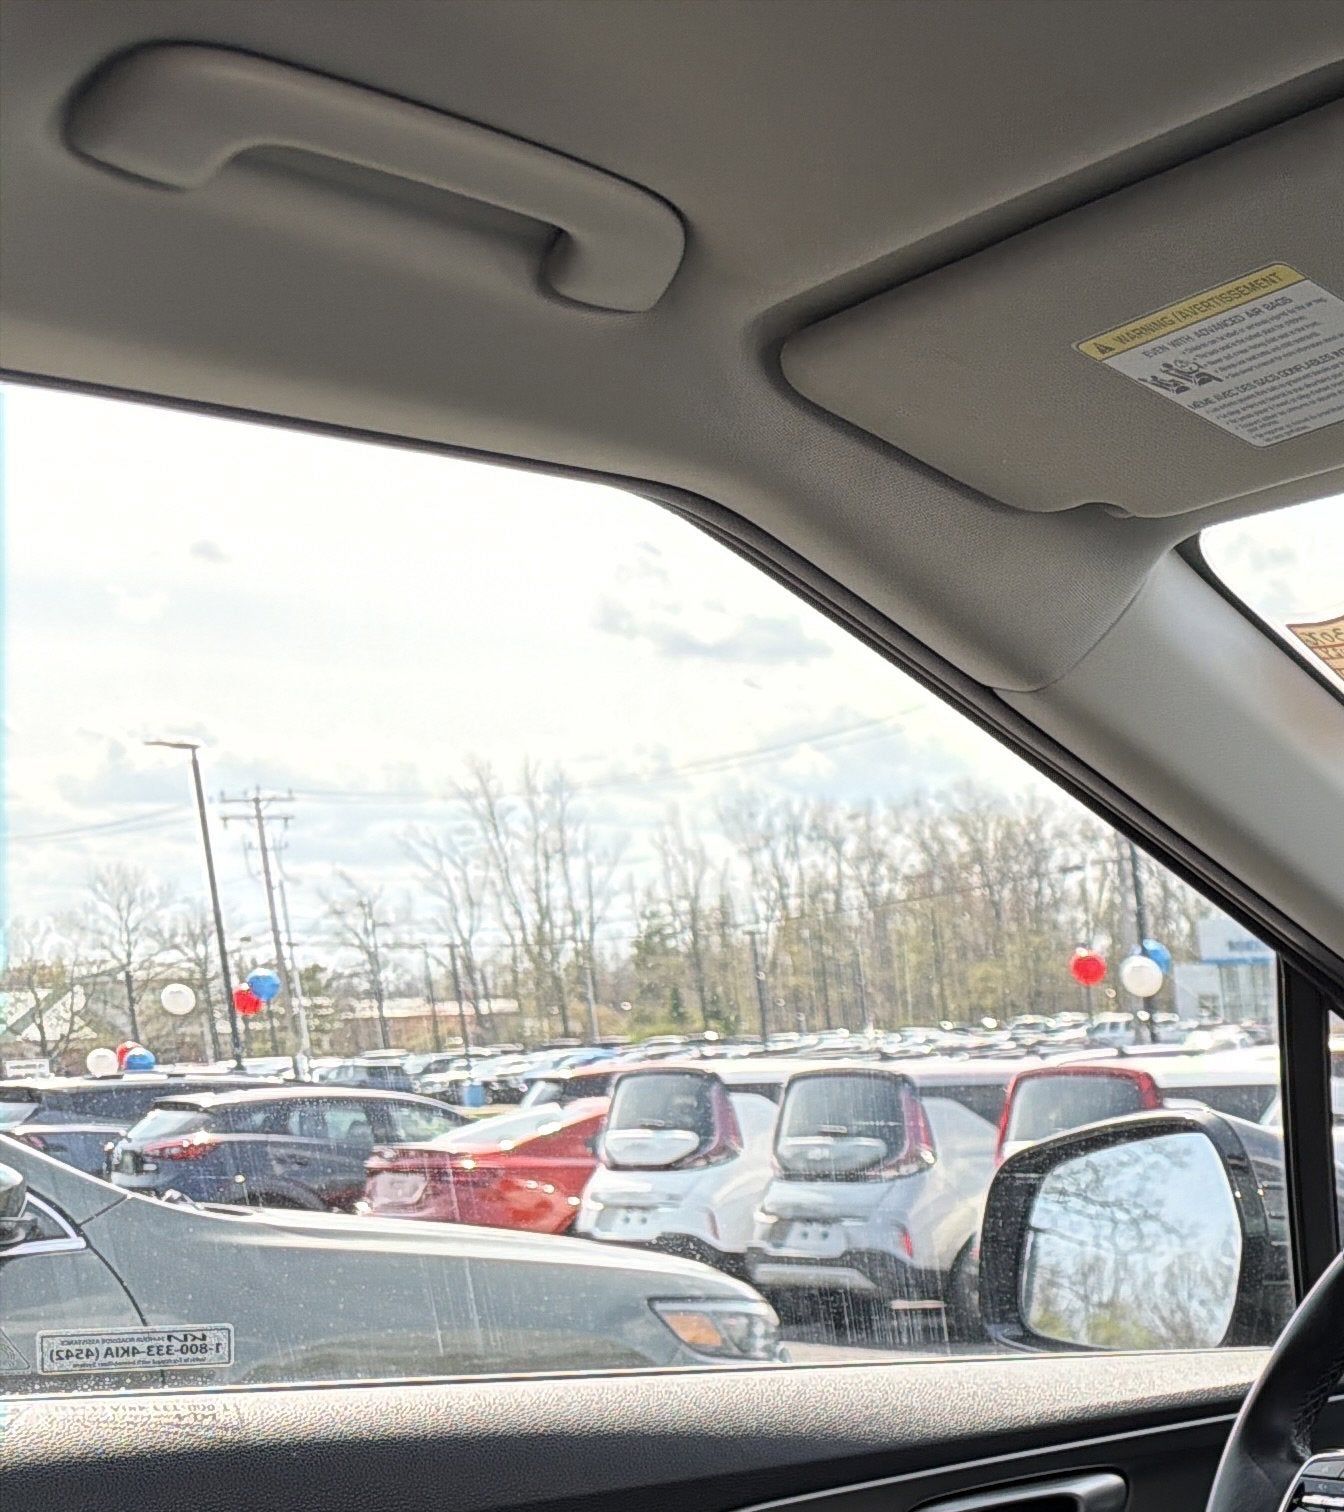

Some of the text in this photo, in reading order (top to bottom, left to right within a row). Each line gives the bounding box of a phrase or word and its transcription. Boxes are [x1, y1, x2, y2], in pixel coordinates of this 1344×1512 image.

[1113, 315, 1175, 345] WARNING
[1143, 296, 1293, 358] EVEN WITH ADVANCED AIR BAGS
